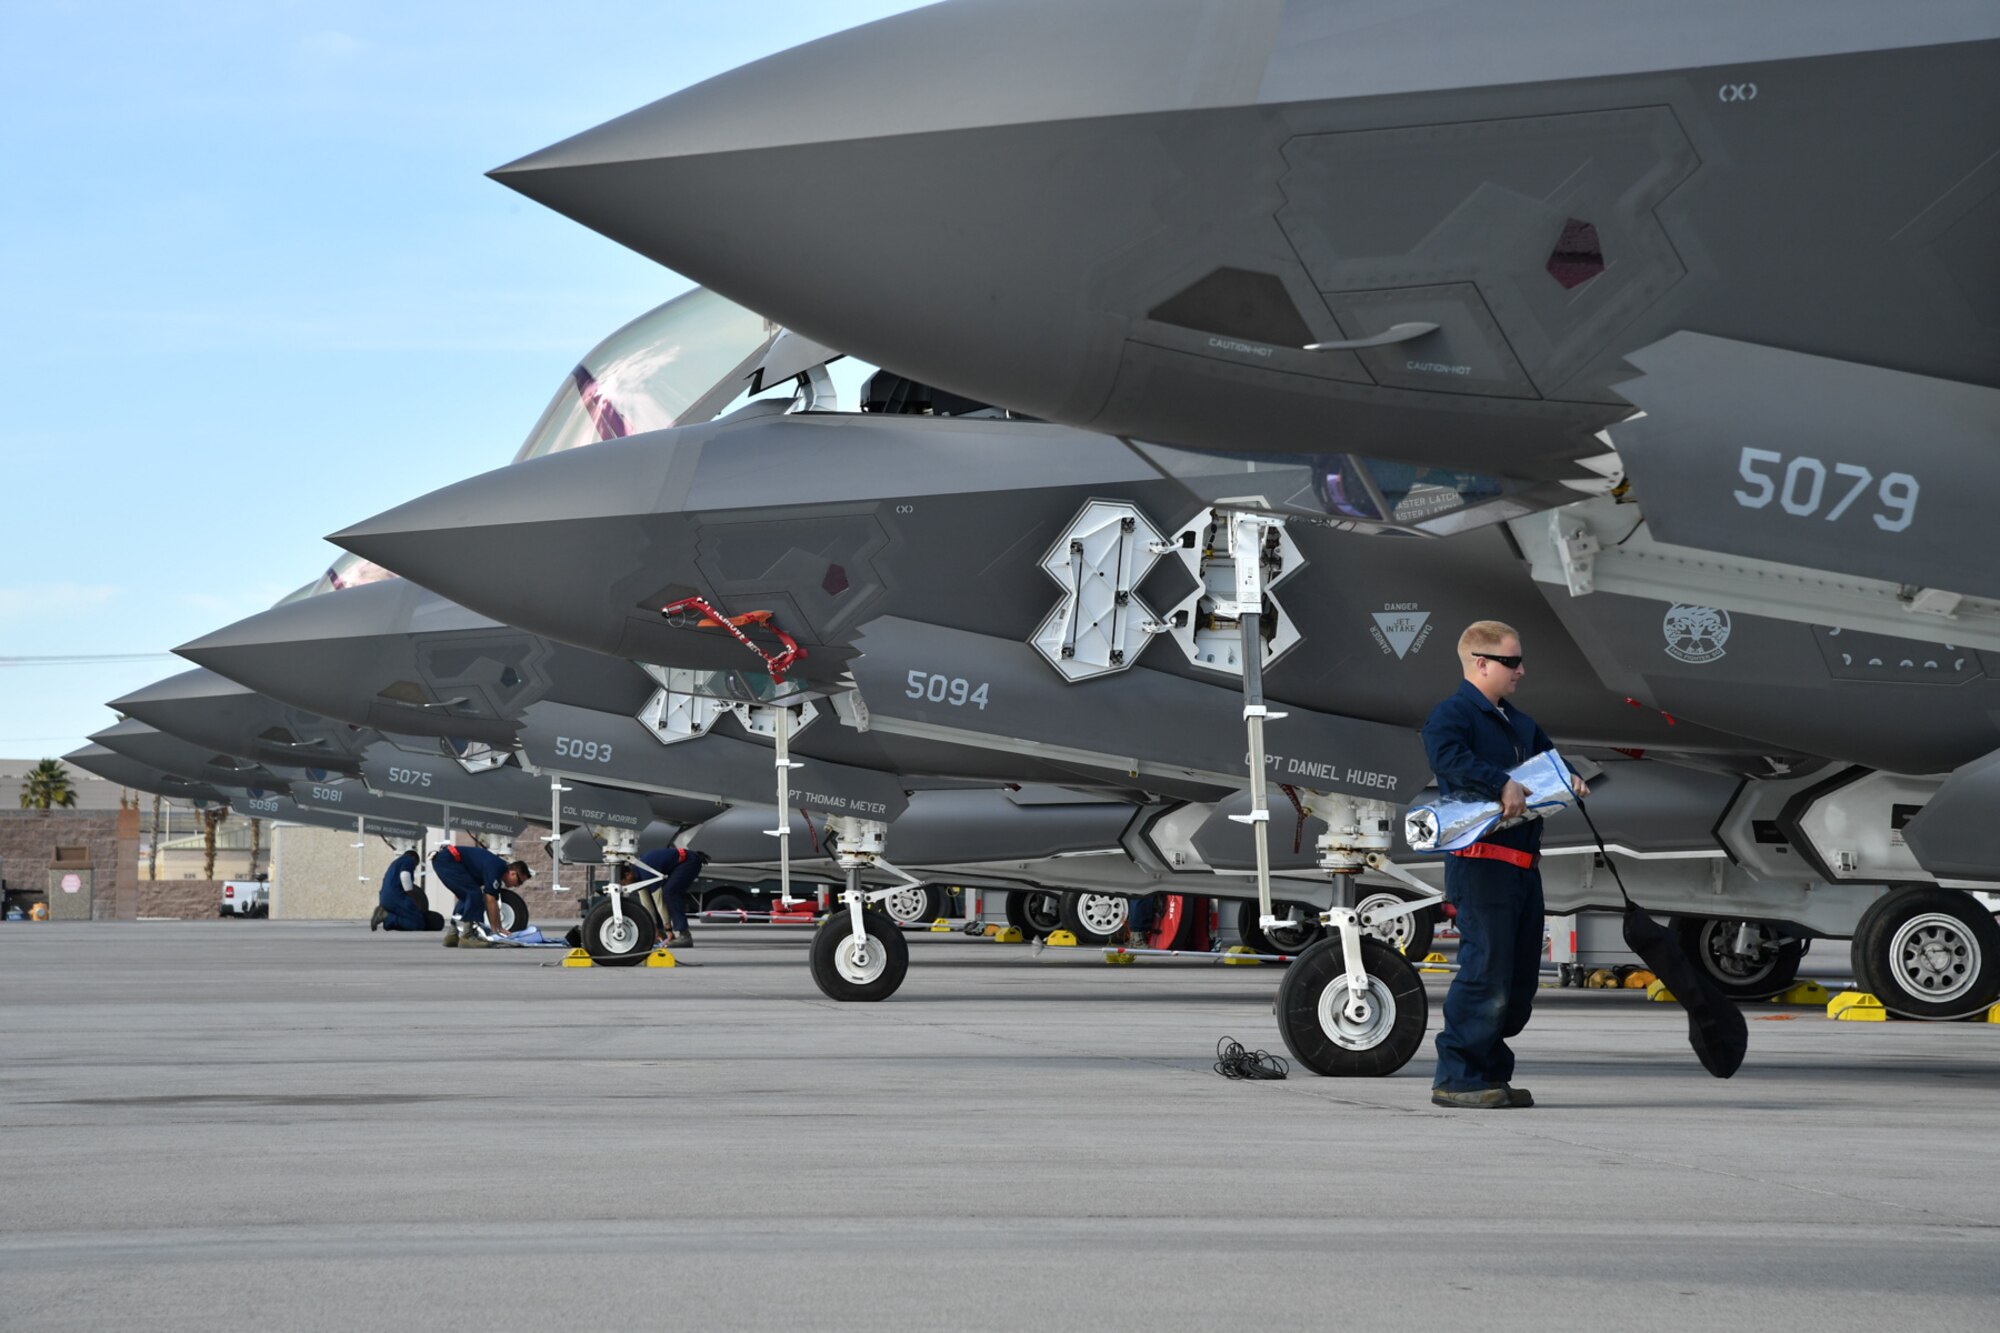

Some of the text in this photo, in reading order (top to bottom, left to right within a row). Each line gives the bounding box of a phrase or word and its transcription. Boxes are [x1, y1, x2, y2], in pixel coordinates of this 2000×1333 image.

[1208, 338, 1274, 357] CAUTION-HOT
[1406, 361, 1472, 376] CAUTION-HOT
[1733, 446, 1920, 533] 5079
[1395, 492, 1459, 510] ASTER LATCH
[1395, 509, 1424, 521] ASTER
[1384, 602, 1418, 611] DANGER
[1386, 625, 1416, 633] INTAKE
[1410, 623, 1433, 654] DANGER
[1369, 625, 1392, 655] DANGER
[905, 670, 989, 710] 5094
[555, 736, 613, 762] 5093
[388, 767, 432, 787] 5075
[1244, 752, 1398, 791] CPT DANIEL HUBER
[312, 787, 343, 802] 5081
[805, 792, 847, 807] THOMAS
[850, 800, 886, 814] MEYER
[249, 800, 279, 812] 5098
[562, 806, 637, 825] COL YOSEF MORRIS
